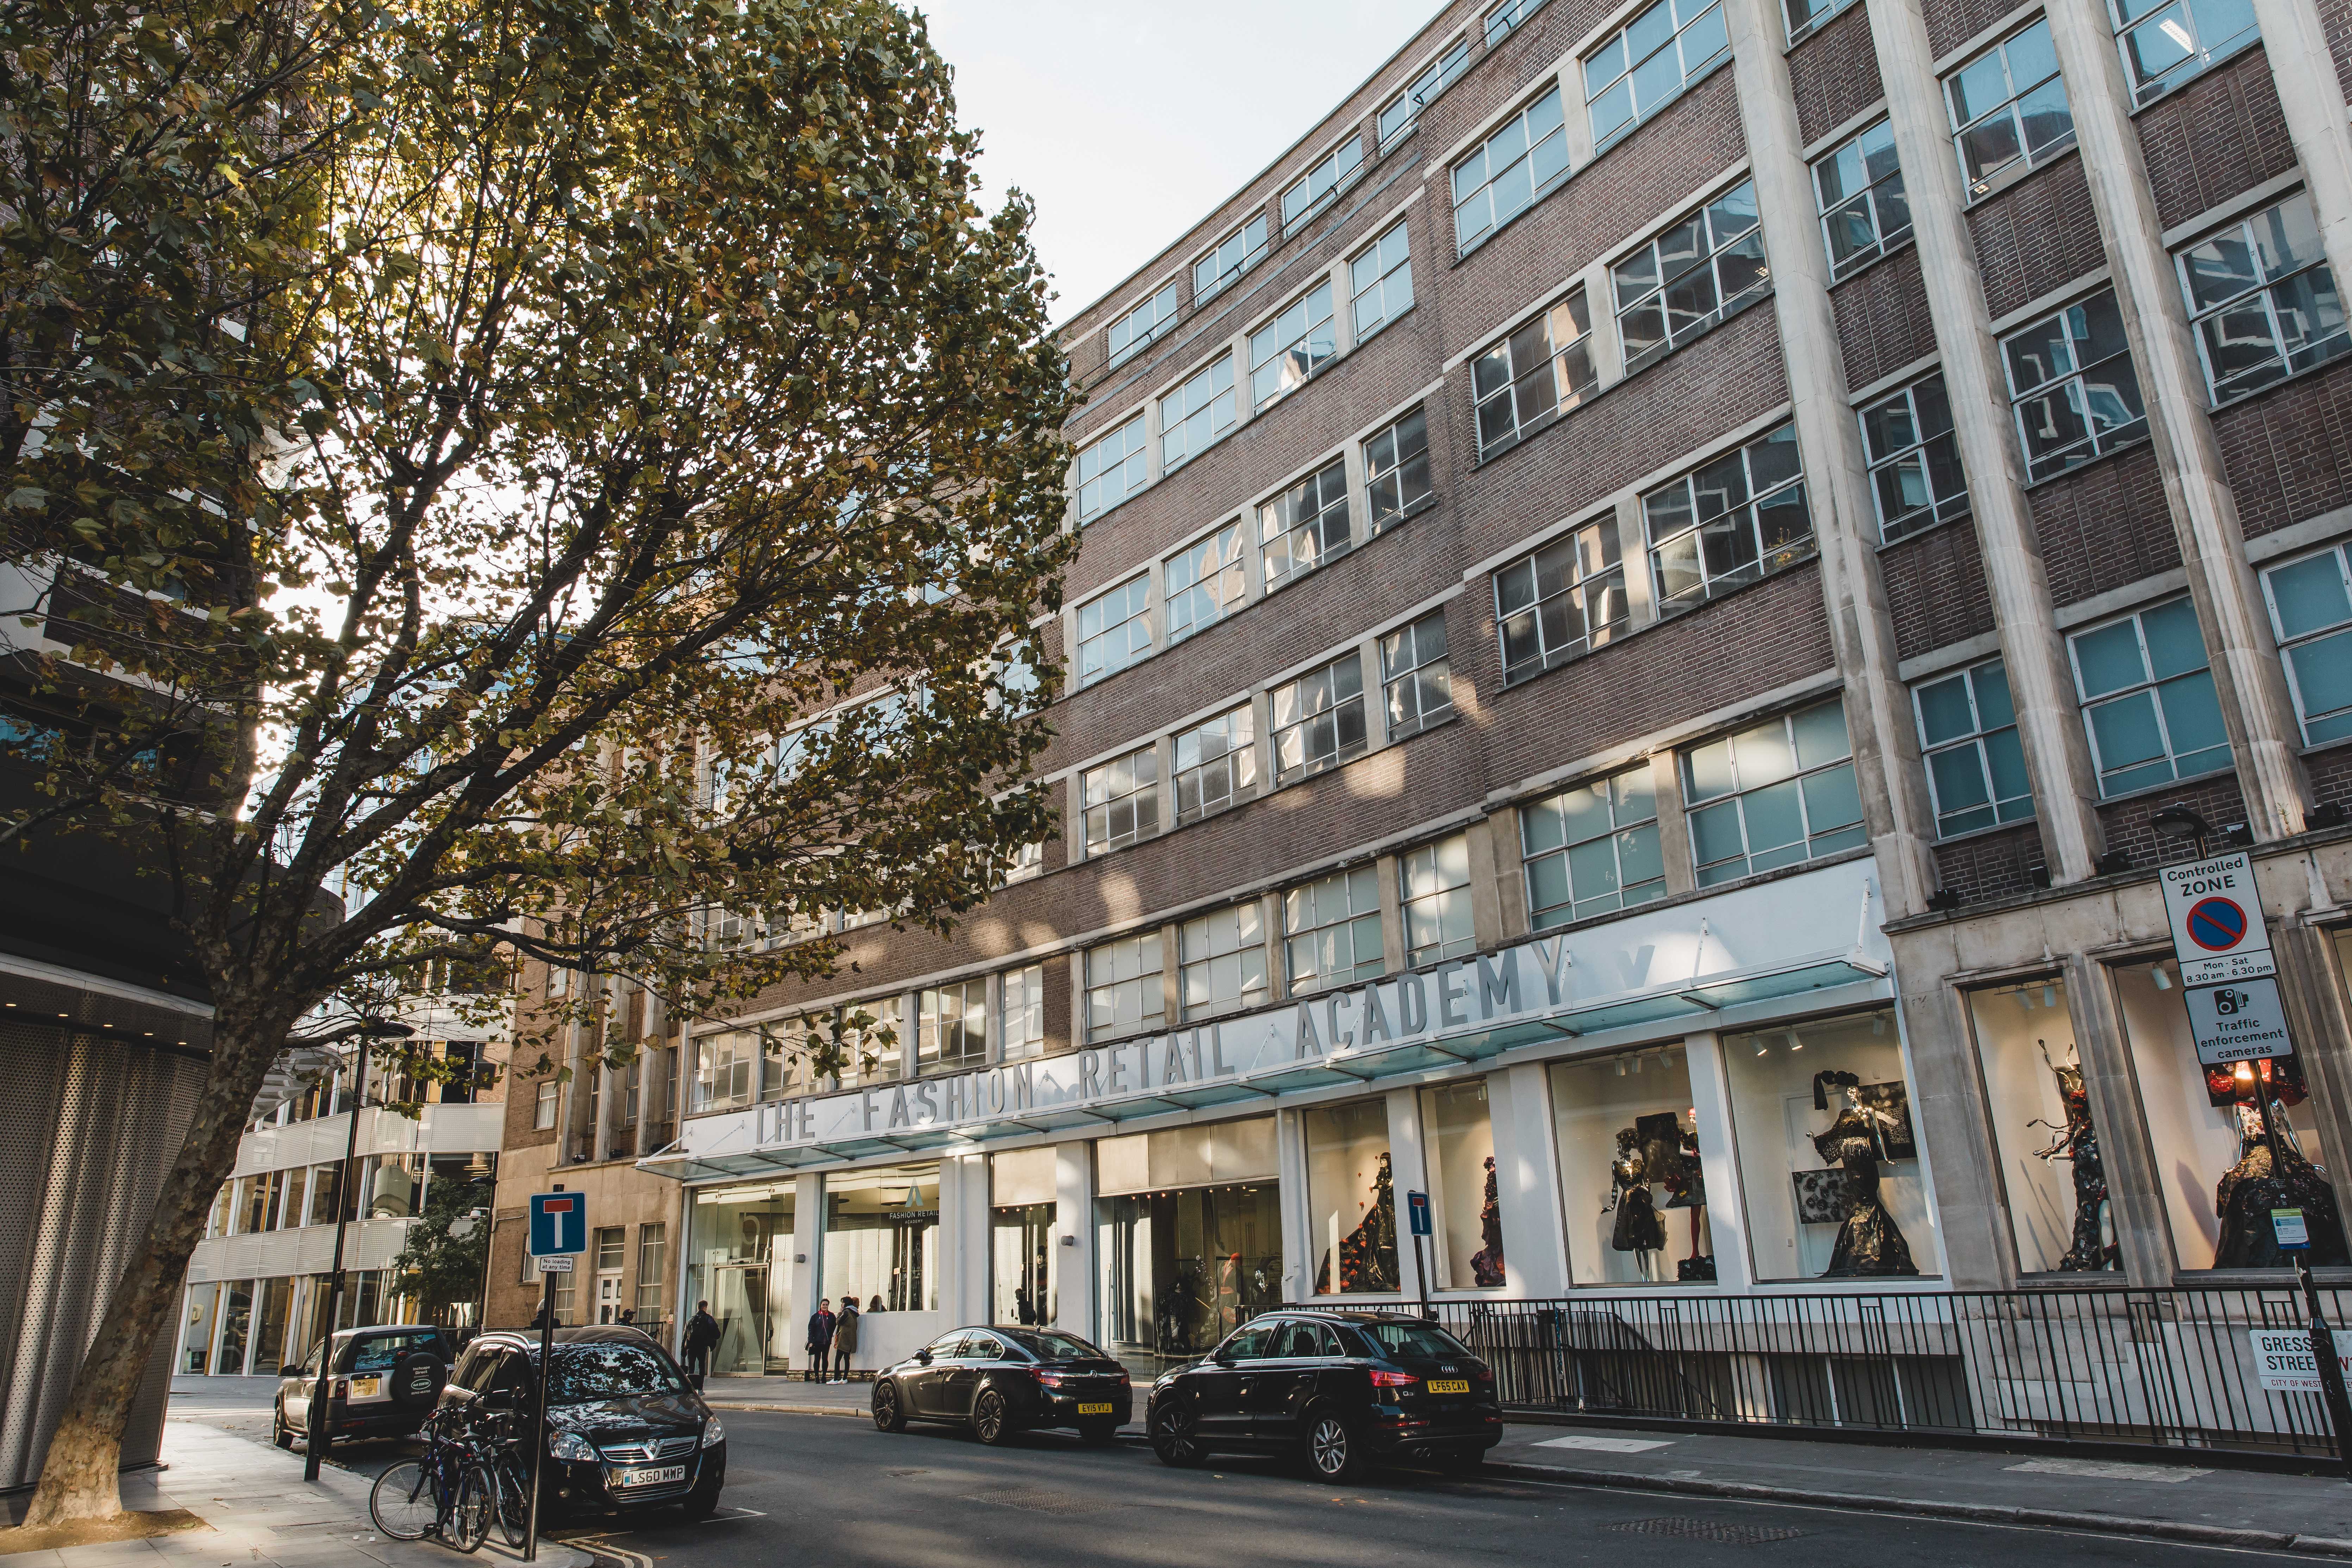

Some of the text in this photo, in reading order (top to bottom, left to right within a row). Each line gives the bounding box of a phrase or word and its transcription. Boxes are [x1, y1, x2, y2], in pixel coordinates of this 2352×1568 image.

[2167, 857, 2243, 881] Controlled
[2181, 875, 2235, 897] ZONE
[2231, 957, 2248, 966] Sat
[2186, 973, 2209, 983] 8.30
[2231, 966, 2255, 976] 6.30
[2256, 965, 2272, 973] pm
[2215, 1018, 2260, 1032] Traffic
[752, 934, 1563, 1144] THE FASHION RETAIL ACADEMY
[2201, 1028, 2284, 1047] enforcement
[2218, 1045, 2272, 1059] cameras
[889, 1211, 915, 1219] FASHION
[2261, 1336, 2313, 1352] GRESS
[2266, 1355, 2316, 1371] STREE
[1431, 1382, 1466, 1391] LF65 CAX
[631, 1467, 683, 1484] LS60 MWP
